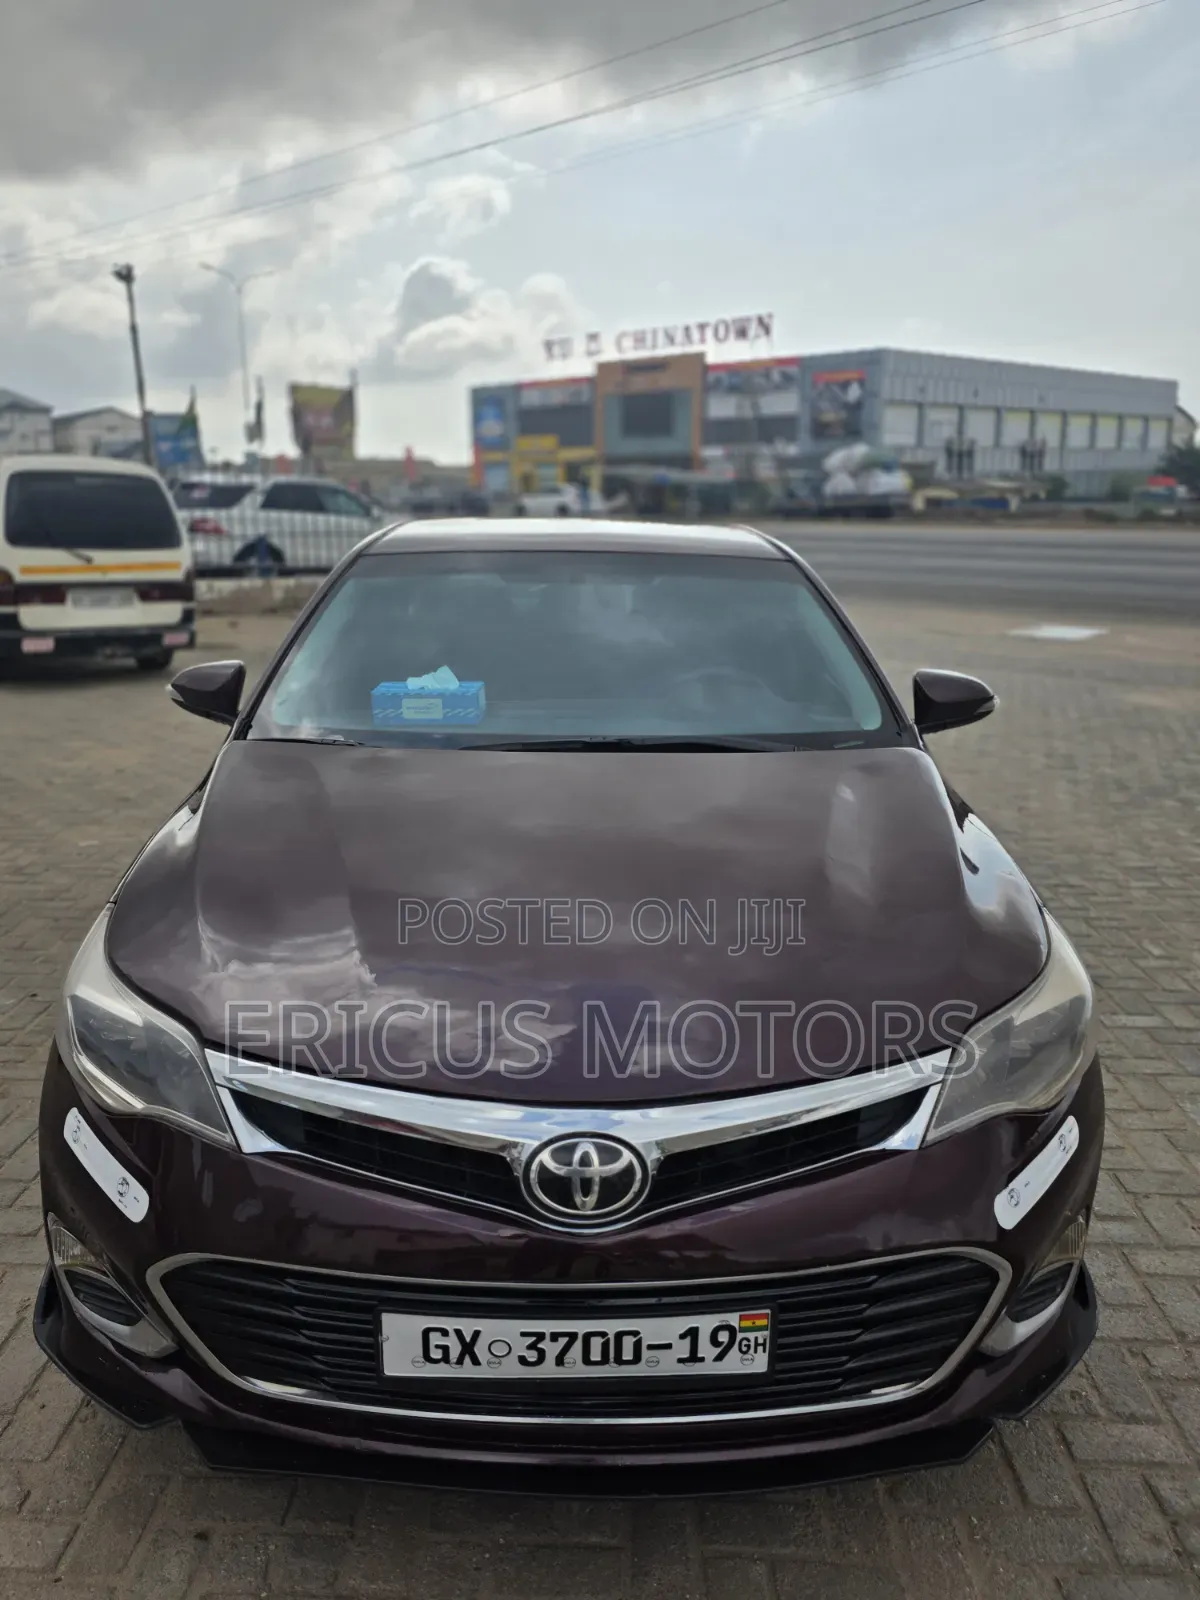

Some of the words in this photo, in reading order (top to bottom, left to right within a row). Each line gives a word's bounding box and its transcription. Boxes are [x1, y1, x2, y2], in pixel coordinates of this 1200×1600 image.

[614, 313, 774, 352] CHINATOWN
[421, 1326, 483, 1366] GX
[517, 1324, 737, 1367] 3700-19
[738, 1336, 767, 1355] GH
